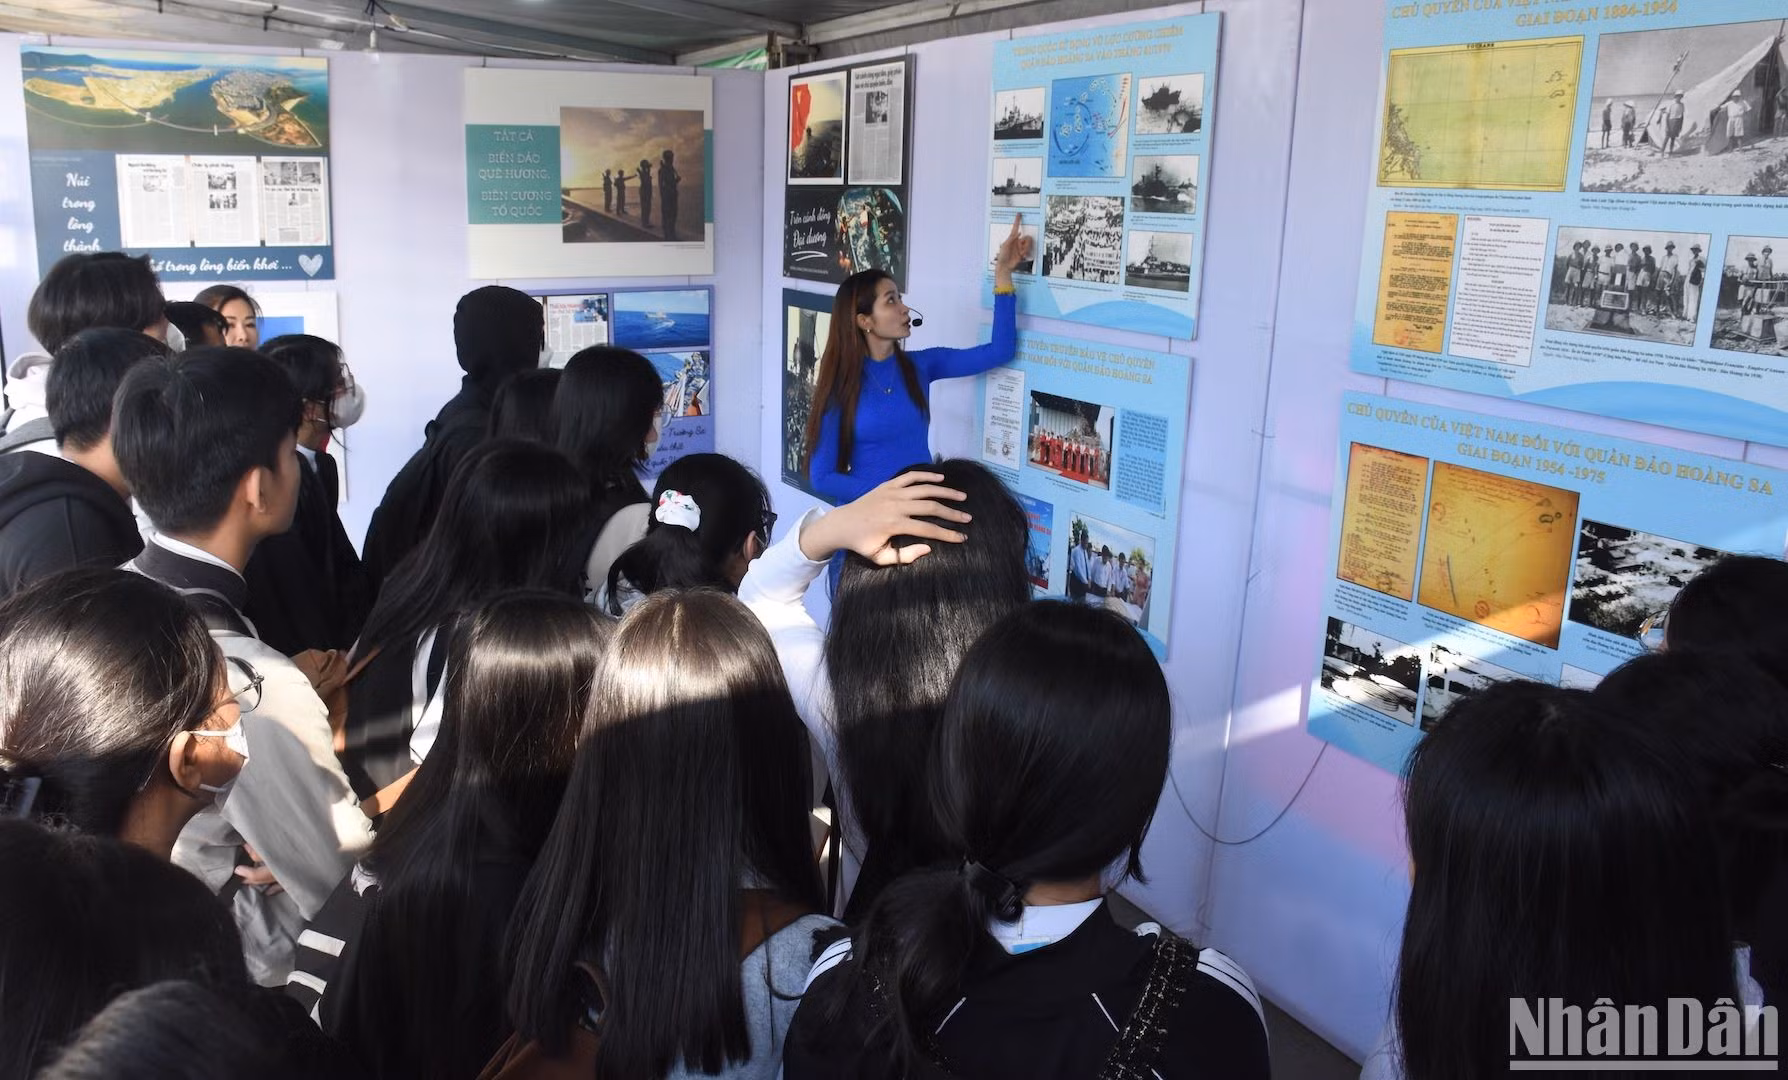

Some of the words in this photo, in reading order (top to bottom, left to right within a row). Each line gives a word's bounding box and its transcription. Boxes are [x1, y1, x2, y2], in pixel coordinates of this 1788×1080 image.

[1515, 11, 1550, 27] GIAI
[165, 259, 197, 275] trong
[199, 257, 225, 275] lòng
[1347, 402, 1372, 417] CHỦ
[1375, 407, 1419, 427] QUYỀN
[1421, 415, 1448, 432] CỦA
[1451, 421, 1483, 440] VIỆT
[1485, 427, 1519, 446] NAM
[1675, 463, 1744, 490] HOÀNG
[1747, 477, 1773, 496] SA
[1456, 442, 1489, 460] GIAI
